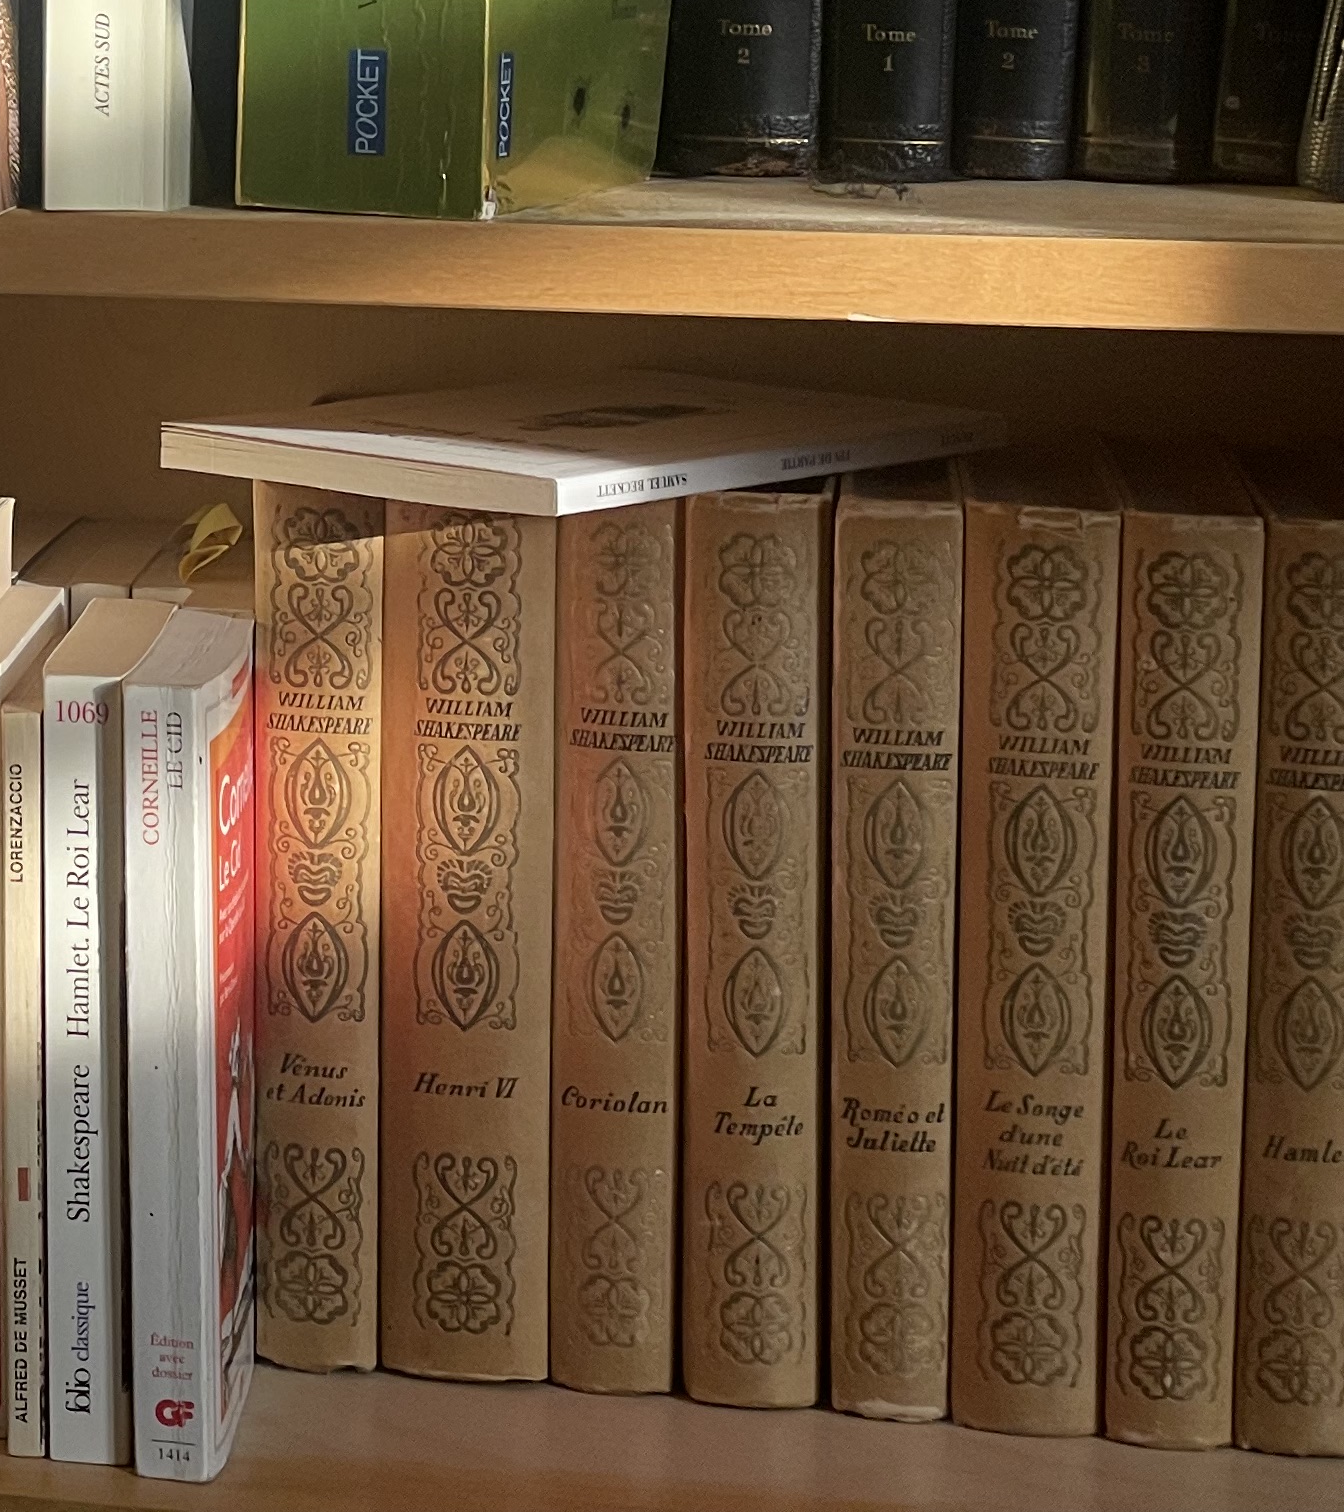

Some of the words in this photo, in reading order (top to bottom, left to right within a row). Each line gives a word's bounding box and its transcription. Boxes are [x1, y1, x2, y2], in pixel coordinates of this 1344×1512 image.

[719, 20, 772, 37] Tome
[862, 23, 917, 42] Tome
[355, 49, 379, 154] POCKET
[498, 54, 512, 158] POCKET
[55, 700, 109, 724] 1069
[278, 692, 363, 711] WILLIAM
[425, 698, 513, 718] WILLIAM
[267, 714, 373, 735] SHAKESPEARE
[581, 707, 669, 729] WILLIAM
[414, 720, 521, 742] SHAKESPEARE
[852, 727, 943, 746] WILLIAM
[999, 735, 1091, 756] WILLIAM
[1141, 744, 1231, 765] WILLIAM
[841, 750, 952, 771] SHAKESPEARE
[987, 758, 1099, 780] SHAKESPEARE
[141, 709, 158, 846] CORNEILLE
[10, 763, 22, 882] LORENZACCIO
[279, 1053, 348, 1080] Vénus
[561, 1089, 669, 1115] Coriolan
[846, 1128, 936, 1153] Juliette
[14, 1257, 27, 1325] MUSSET
[72, 1282, 95, 1362] classique
[14, 1329, 27, 1353] DE
[15, 1356, 28, 1423] ALFRED
[65, 1370, 91, 1415] folio
[158, 1448, 190, 1462] 1414
